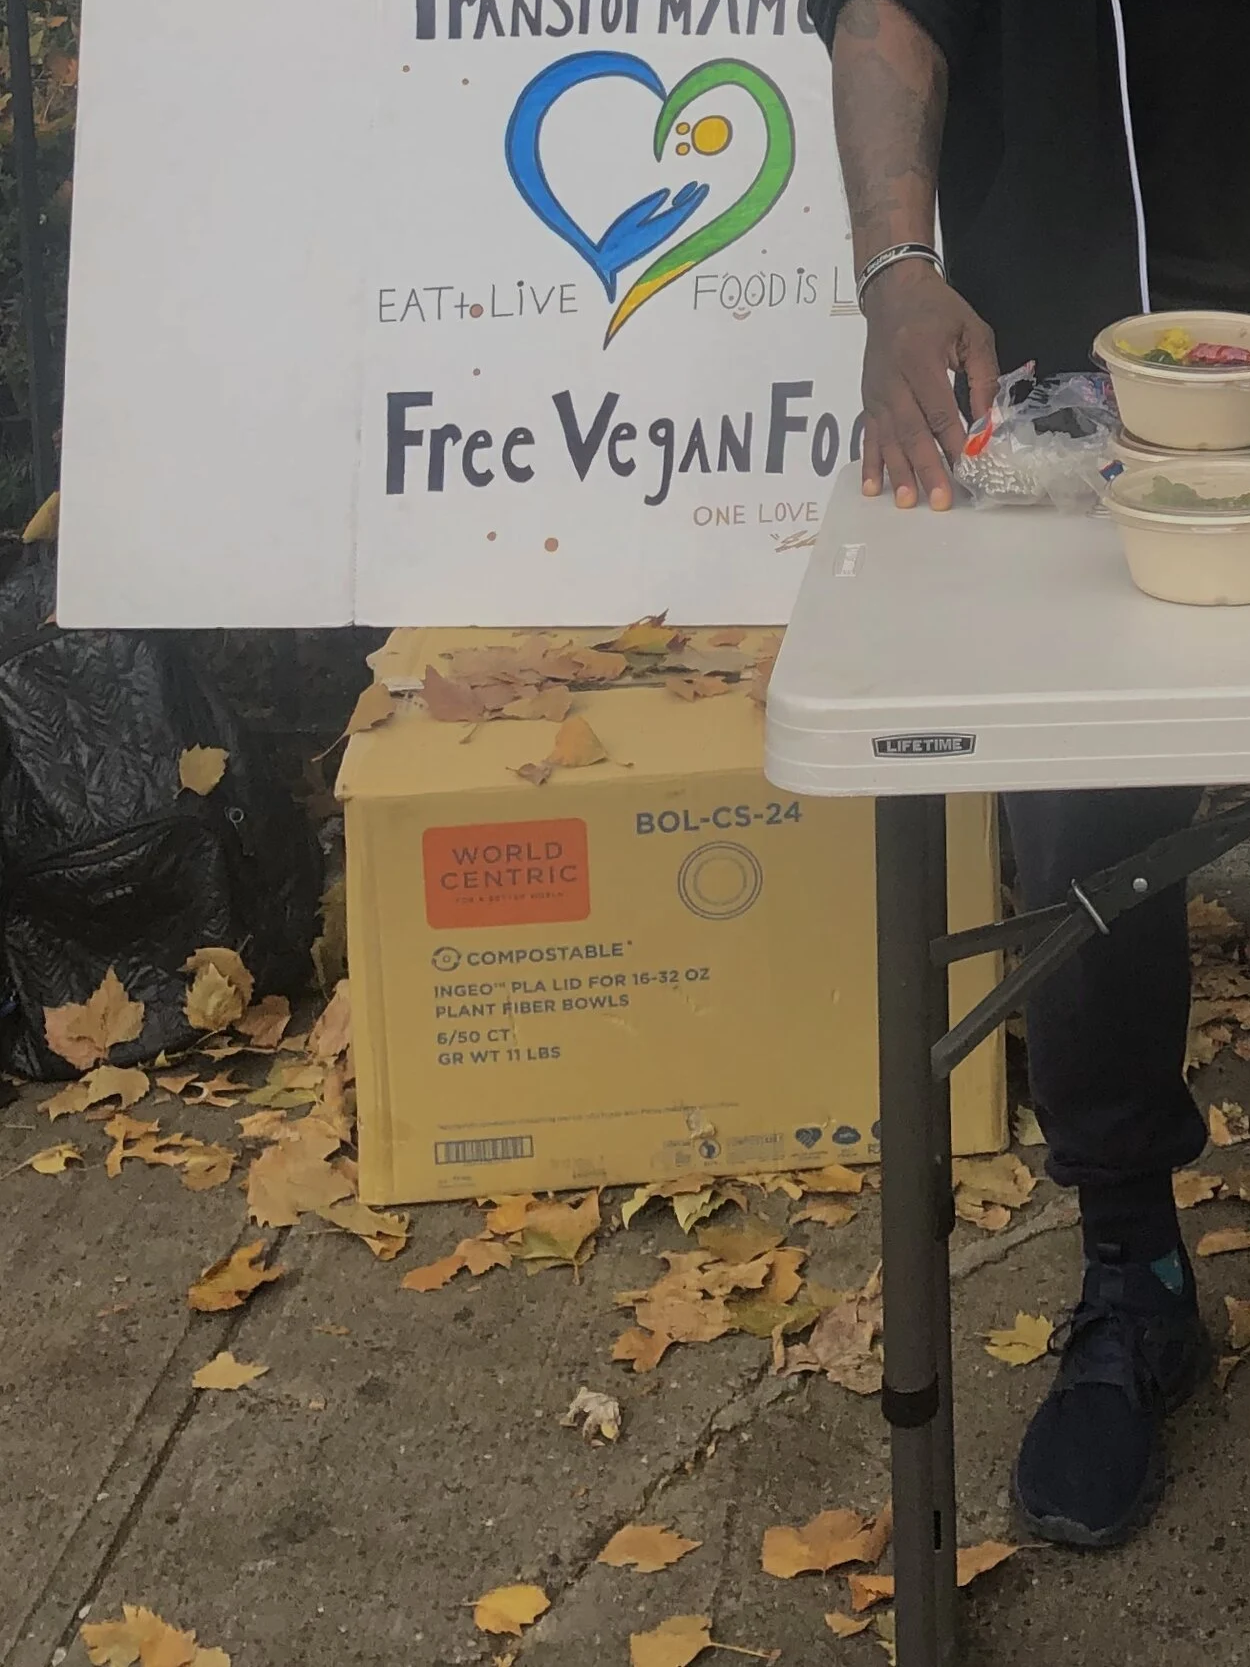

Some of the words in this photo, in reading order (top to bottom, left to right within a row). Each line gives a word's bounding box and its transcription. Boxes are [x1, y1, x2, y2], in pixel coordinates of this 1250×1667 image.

[378, 286, 455, 322] EAT
[694, 271, 787, 311] FOOD
[385, 390, 536, 495] Free
[693, 505, 746, 527] ONE
[758, 501, 820, 524] LOVE
[886, 738, 963, 753] LIFETIME
[635, 801, 803, 836] BOL-CS-24
[452, 842, 563, 866] WORLD
[440, 865, 578, 891] CENTRIC
[511, 980, 547, 994] PLA
[552, 978, 583, 992] LID
[588, 973, 627, 989] FOR
[632, 970, 679, 986] 16-32
[685, 967, 711, 982] OZ
[436, 1003, 497, 1018] PLANT
[502, 999, 556, 1015] FIBER
[562, 994, 629, 1012] BOWLS
[437, 1030, 481, 1046] 6/50
[487, 1028, 511, 1042] CT
[438, 1051, 464, 1066] GR
[470, 1049, 501, 1064] WT
[507, 1048, 521, 1062] 11
[527, 1046, 561, 1061] LBS
